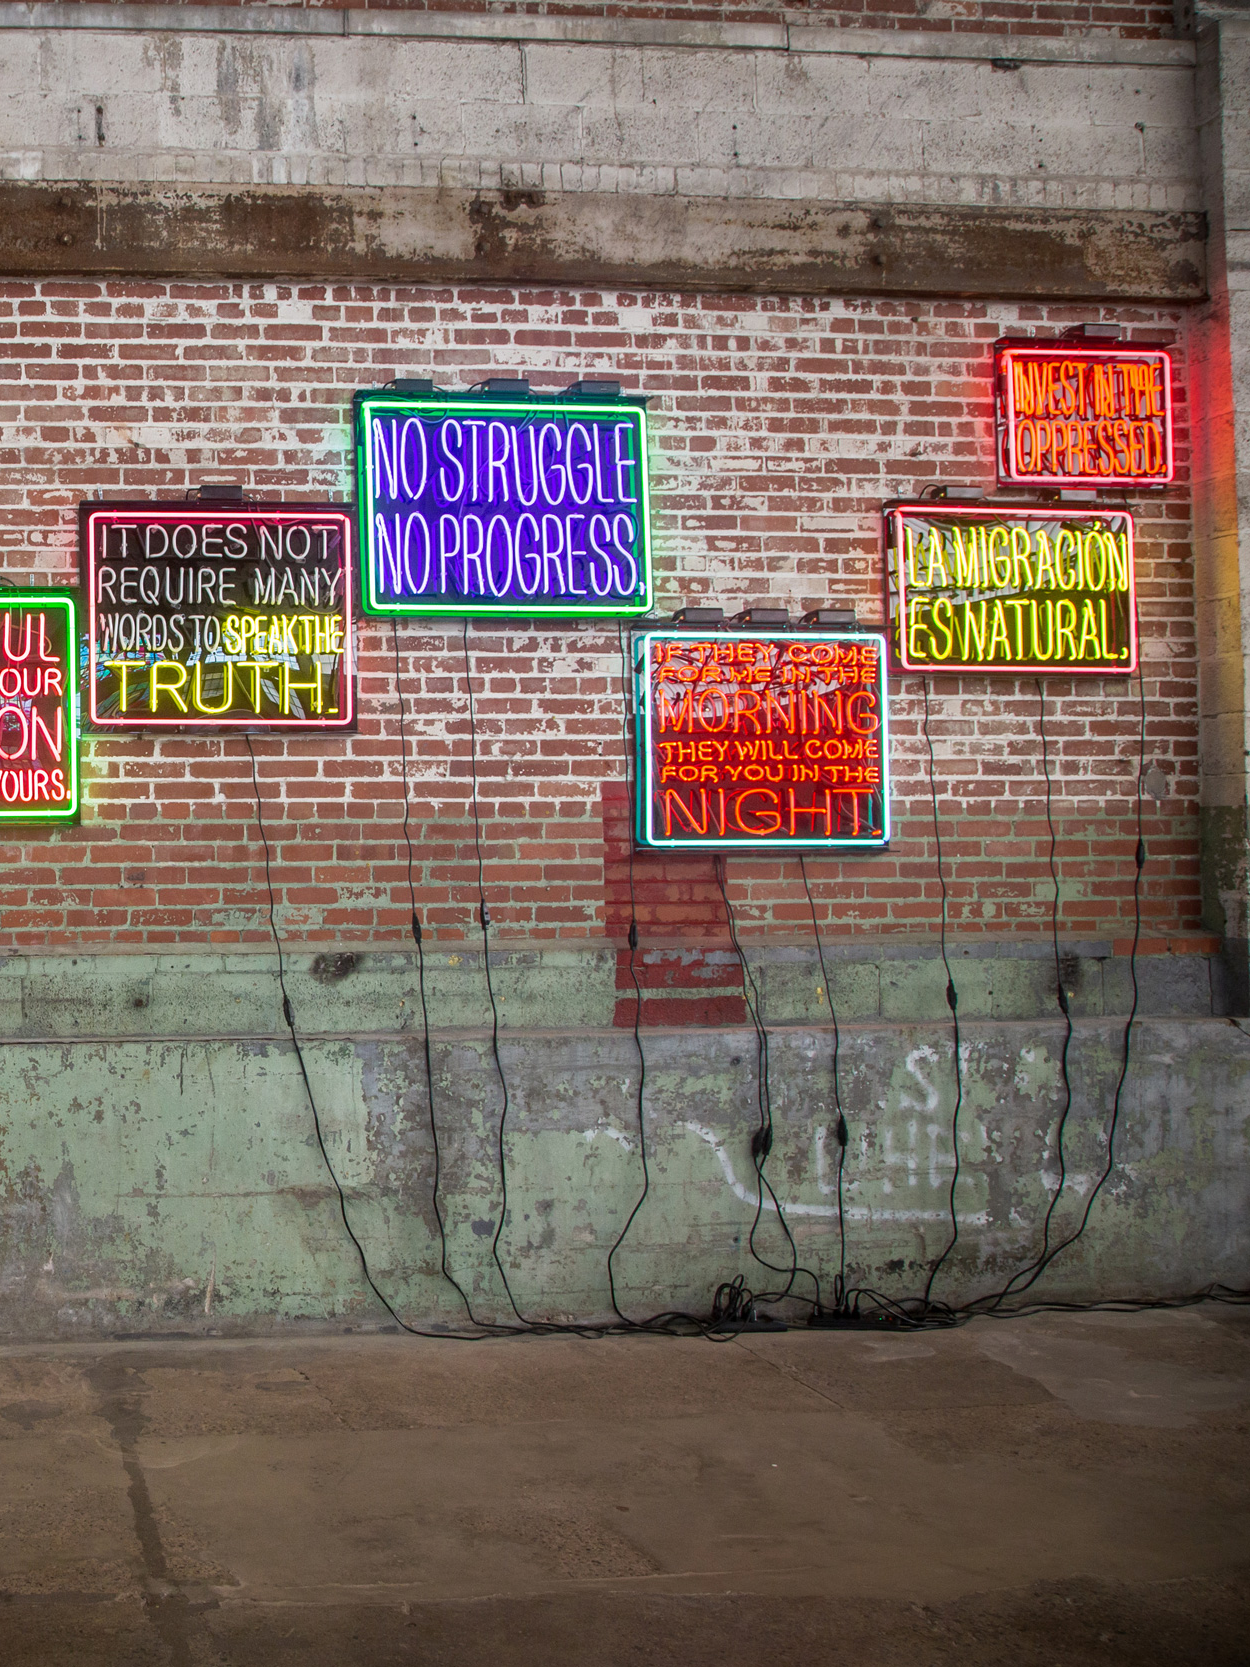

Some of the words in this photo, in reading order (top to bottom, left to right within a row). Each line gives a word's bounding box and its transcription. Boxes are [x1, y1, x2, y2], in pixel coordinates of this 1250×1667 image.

[1013, 360, 1087, 415] INVEST
[1094, 364, 1115, 417] IN
[1116, 363, 1165, 416] THE
[373, 418, 427, 500] NO
[440, 418, 637, 505] STRUGGLE
[1017, 419, 1167, 474] OPPRESSED.
[101, 524, 137, 559] IT
[146, 524, 247, 560] DOES
[260, 524, 338, 560] NOT
[375, 511, 430, 594] NO
[905, 526, 947, 588] LA
[952, 521, 1129, 592] MIGRACIÓN
[98, 566, 236, 605] REQUIRE
[254, 566, 340, 606] MANY
[100, 612, 184, 652] WORDS
[188, 614, 220, 652] TO
[225, 614, 298, 654] SPEAK
[298, 614, 344, 654] THE
[909, 596, 953, 660] ES
[655, 643, 682, 663] IF
[690, 643, 775, 664] THEY
[788, 644, 878, 665] COME
[659, 666, 721, 683] FOR
[729, 666, 771, 683] ME
[782, 666, 811, 683] IN
[818, 667, 876, 683] THE
[104, 660, 338, 714] TRUTH.
[659, 688, 879, 735] MORNING
[659, 740, 729, 762] THEY
[734, 740, 798, 760] WILL
[805, 739, 878, 759] COME
[661, 765, 719, 783] FOR
[725, 764, 783, 782] YOU
[792, 765, 820, 781] IN
[824, 766, 879, 782] THE
[664, 788, 882, 836] NIGHT.
